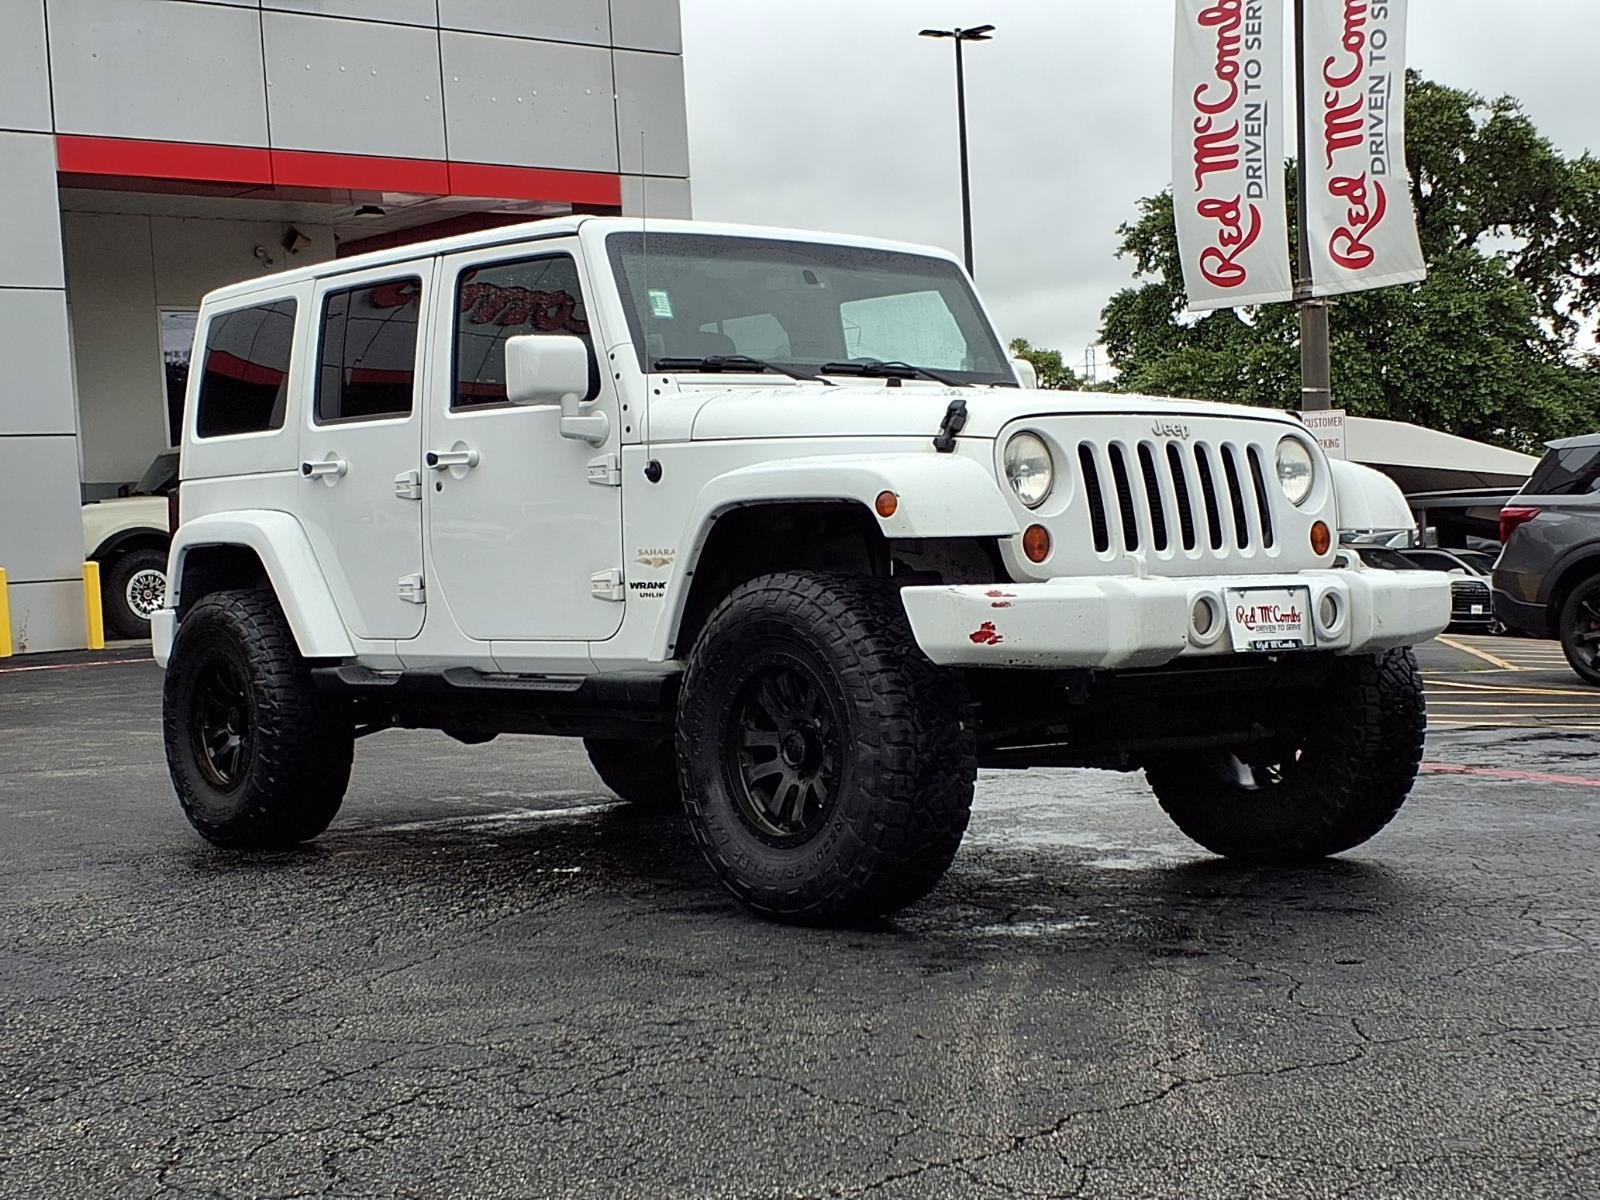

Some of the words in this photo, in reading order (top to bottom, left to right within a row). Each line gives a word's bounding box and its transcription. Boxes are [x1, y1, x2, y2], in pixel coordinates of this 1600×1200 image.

[1369, 29, 1387, 66] TO
[1244, 59, 1262, 95] TO
[1369, 75, 1386, 175] DRIVEN
[1245, 103, 1263, 199] DRIVEN
[1328, 170, 1387, 269] Red
[1197, 194, 1261, 287] Red
[1151, 418, 1191, 441] Jeep
[1304, 416, 1343, 428] CUSTOMER
[638, 548, 676, 557] SAHARA
[1235, 605, 1257, 631] Red
[1257, 605, 1302, 623] McCombs
[1256, 624, 1277, 632] DRIVEN
